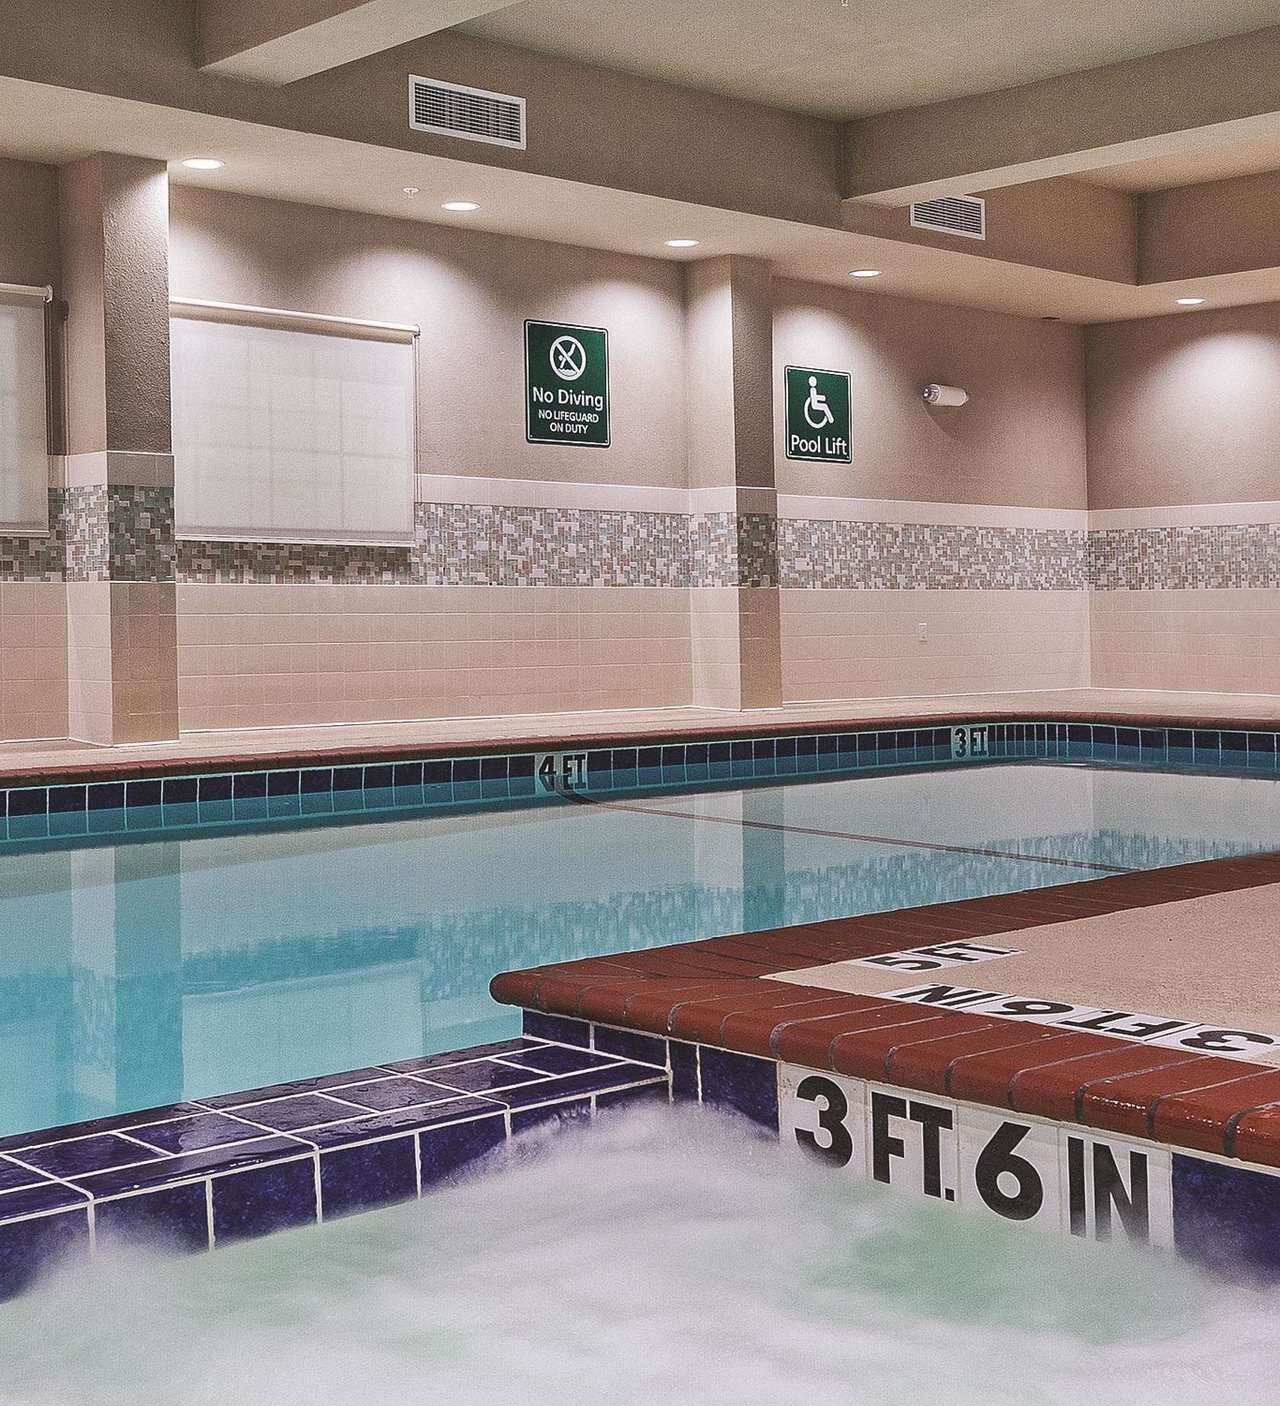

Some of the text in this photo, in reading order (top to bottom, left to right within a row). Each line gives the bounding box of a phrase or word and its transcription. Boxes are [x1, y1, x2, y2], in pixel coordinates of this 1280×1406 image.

[532, 386, 603, 411] No Diving
[538, 408, 599, 423] NO LIFEGUARD
[549, 422, 589, 434] ON DUTY
[791, 434, 848, 456] Pool Lift
[863, 956, 942, 971] 5
[993, 1000, 1075, 1016] 6
[1179, 1029, 1275, 1052] 3
[794, 1075, 853, 1169] 3
[871, 1091, 956, 1202] FT.
[974, 1120, 1044, 1221] 6
